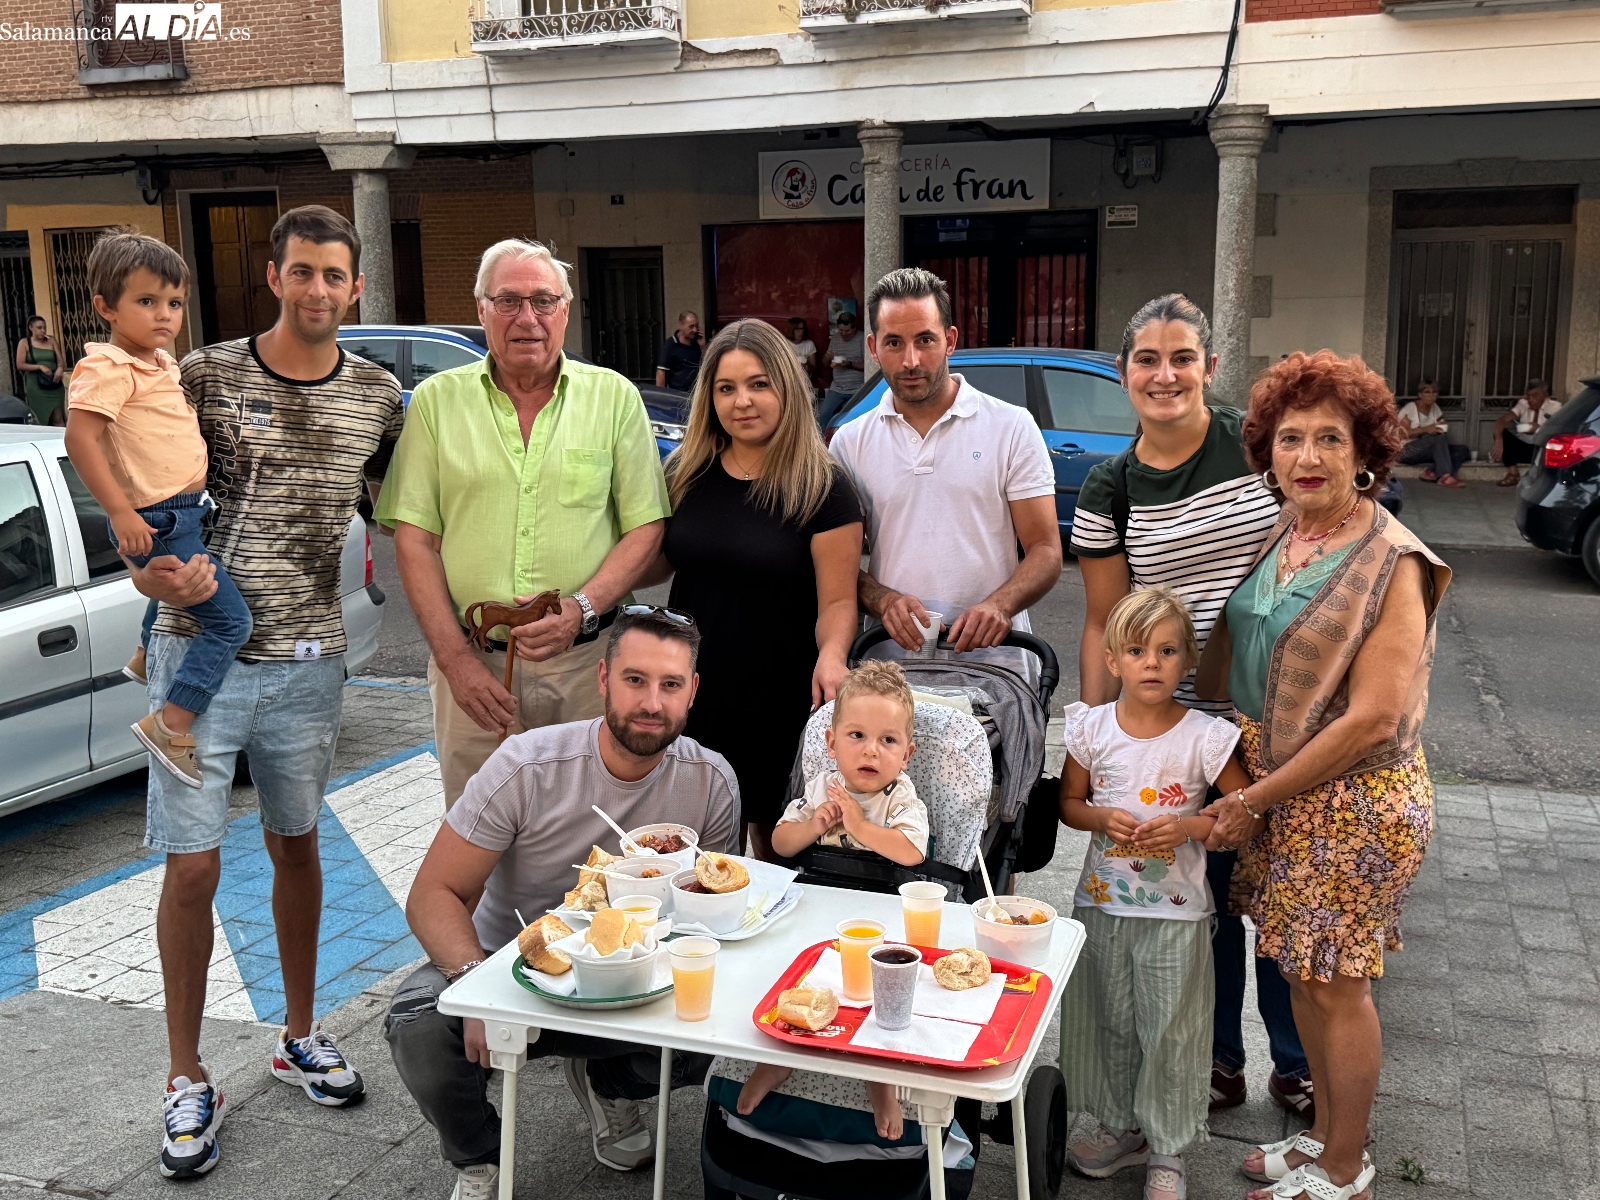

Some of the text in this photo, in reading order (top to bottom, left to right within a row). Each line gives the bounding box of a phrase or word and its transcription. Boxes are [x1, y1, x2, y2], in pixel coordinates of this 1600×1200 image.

[850, 154, 951, 174] CCERÍA
[827, 174, 910, 206] Ca
[916, 176, 945, 203] de
